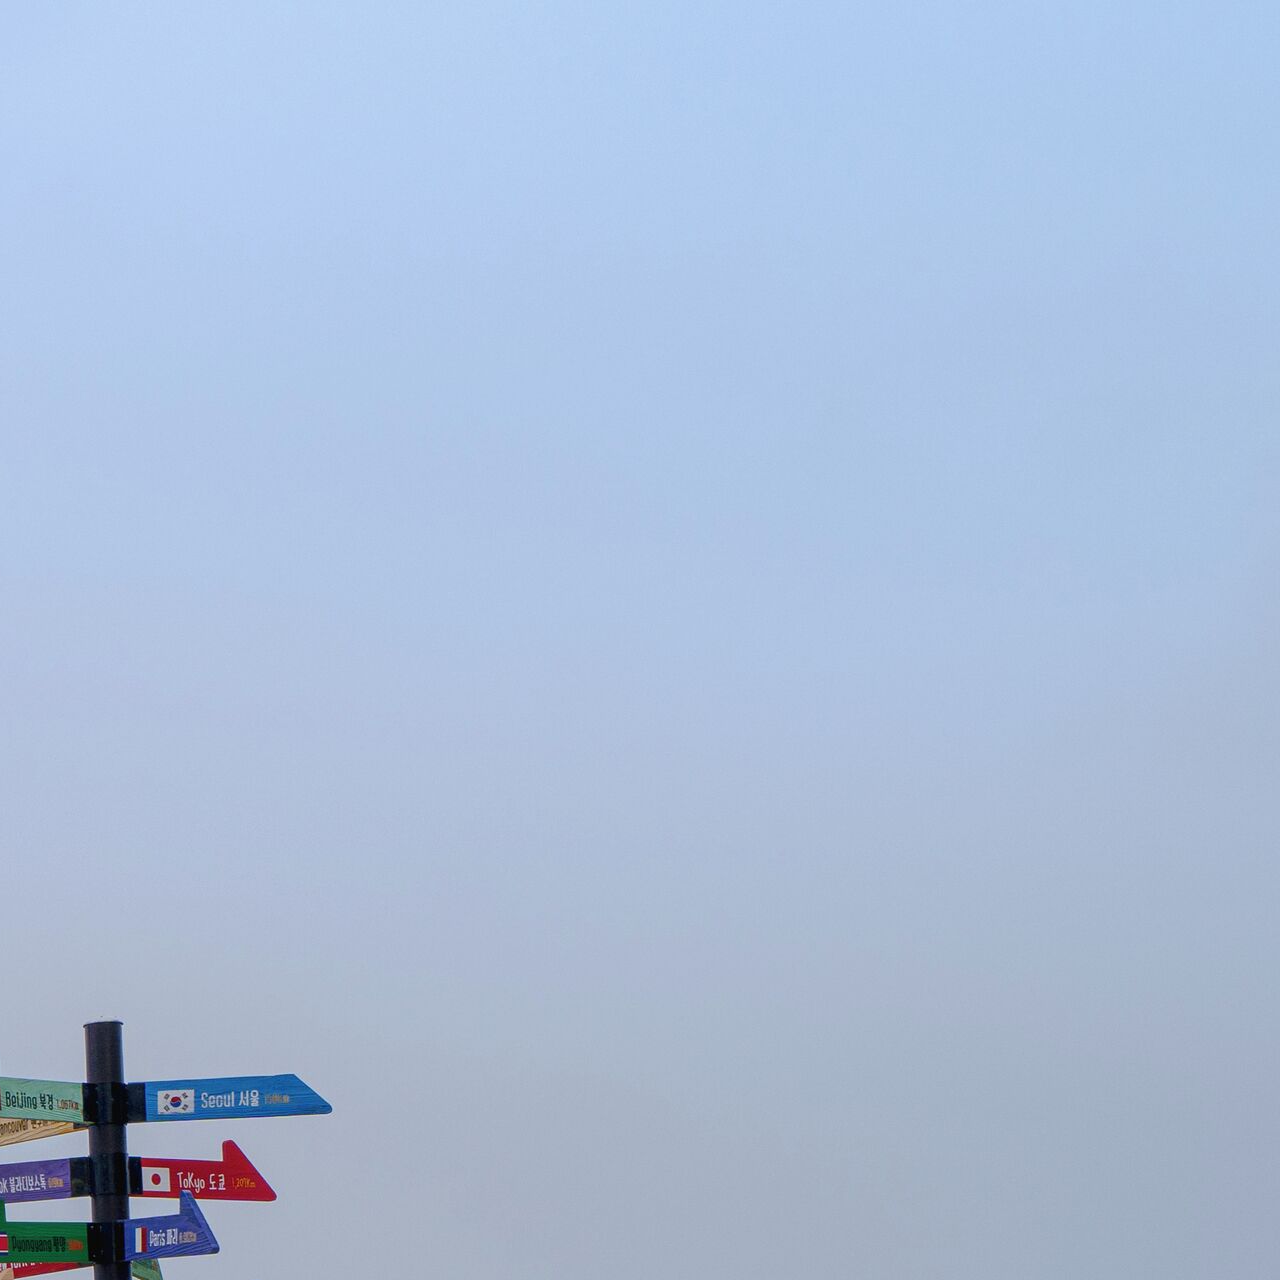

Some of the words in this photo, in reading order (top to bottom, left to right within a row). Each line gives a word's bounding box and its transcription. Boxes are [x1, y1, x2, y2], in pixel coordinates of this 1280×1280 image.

[5, 1091, 38, 1110] Beijing
[40, 1093, 54, 1111] 북경
[201, 1092, 235, 1109] Seoul
[238, 1089, 260, 1107] 서울
[209, 1173, 226, 1191] 도쿄
[149, 1229, 166, 1247] Paris
[166, 1228, 178, 1245] 파리
